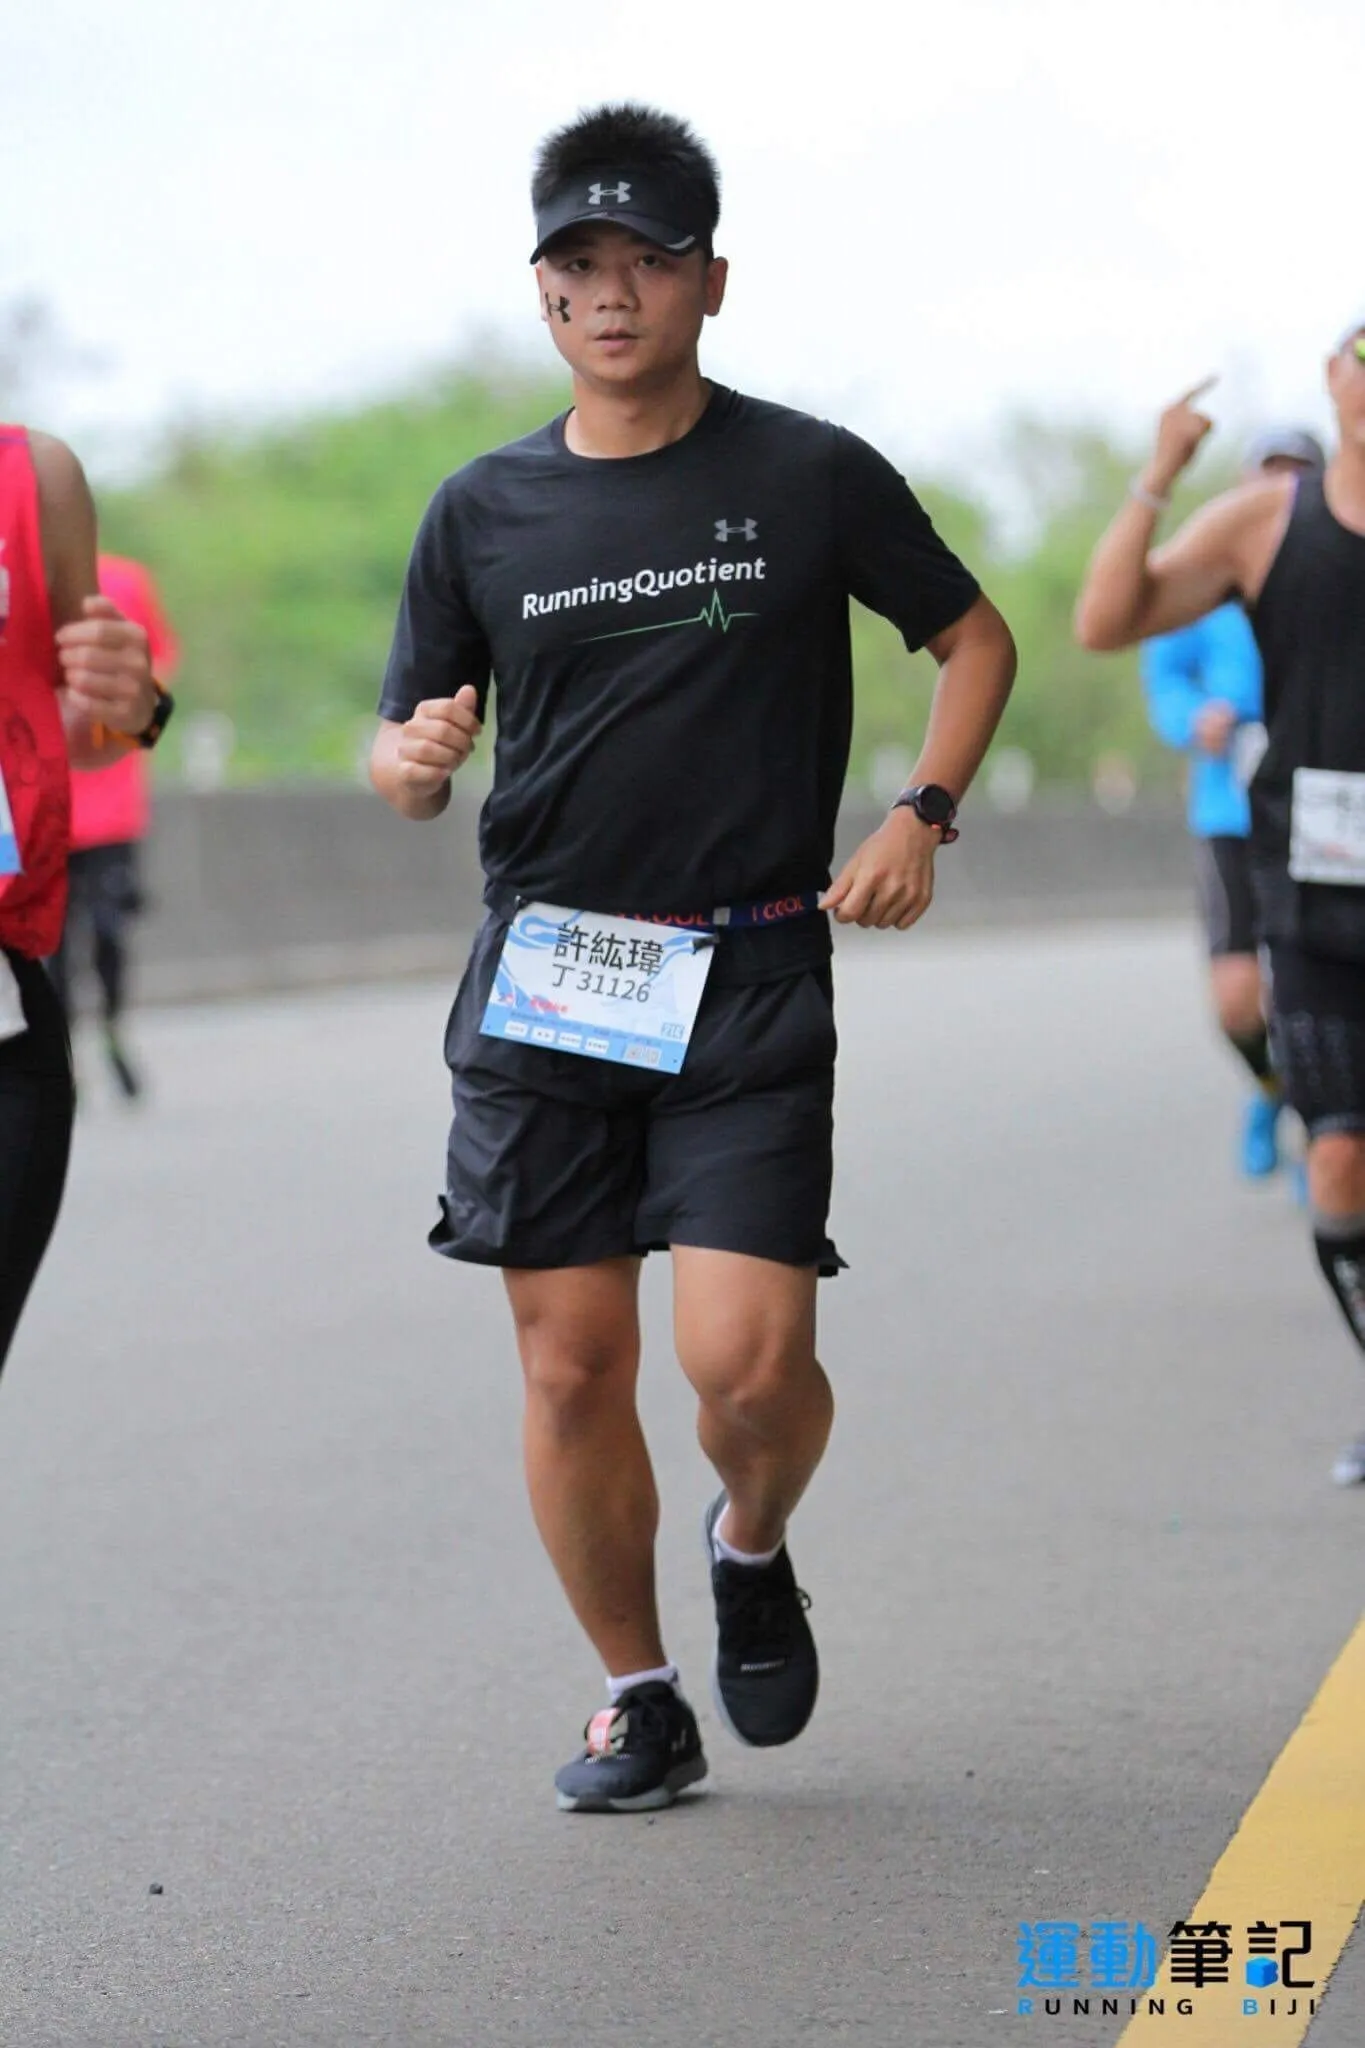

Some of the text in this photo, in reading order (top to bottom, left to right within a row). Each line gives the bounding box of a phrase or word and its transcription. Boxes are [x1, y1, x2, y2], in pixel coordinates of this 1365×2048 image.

[522, 557, 766, 620] RunningQuotient
[554, 922, 664, 976] 許紘瑋
